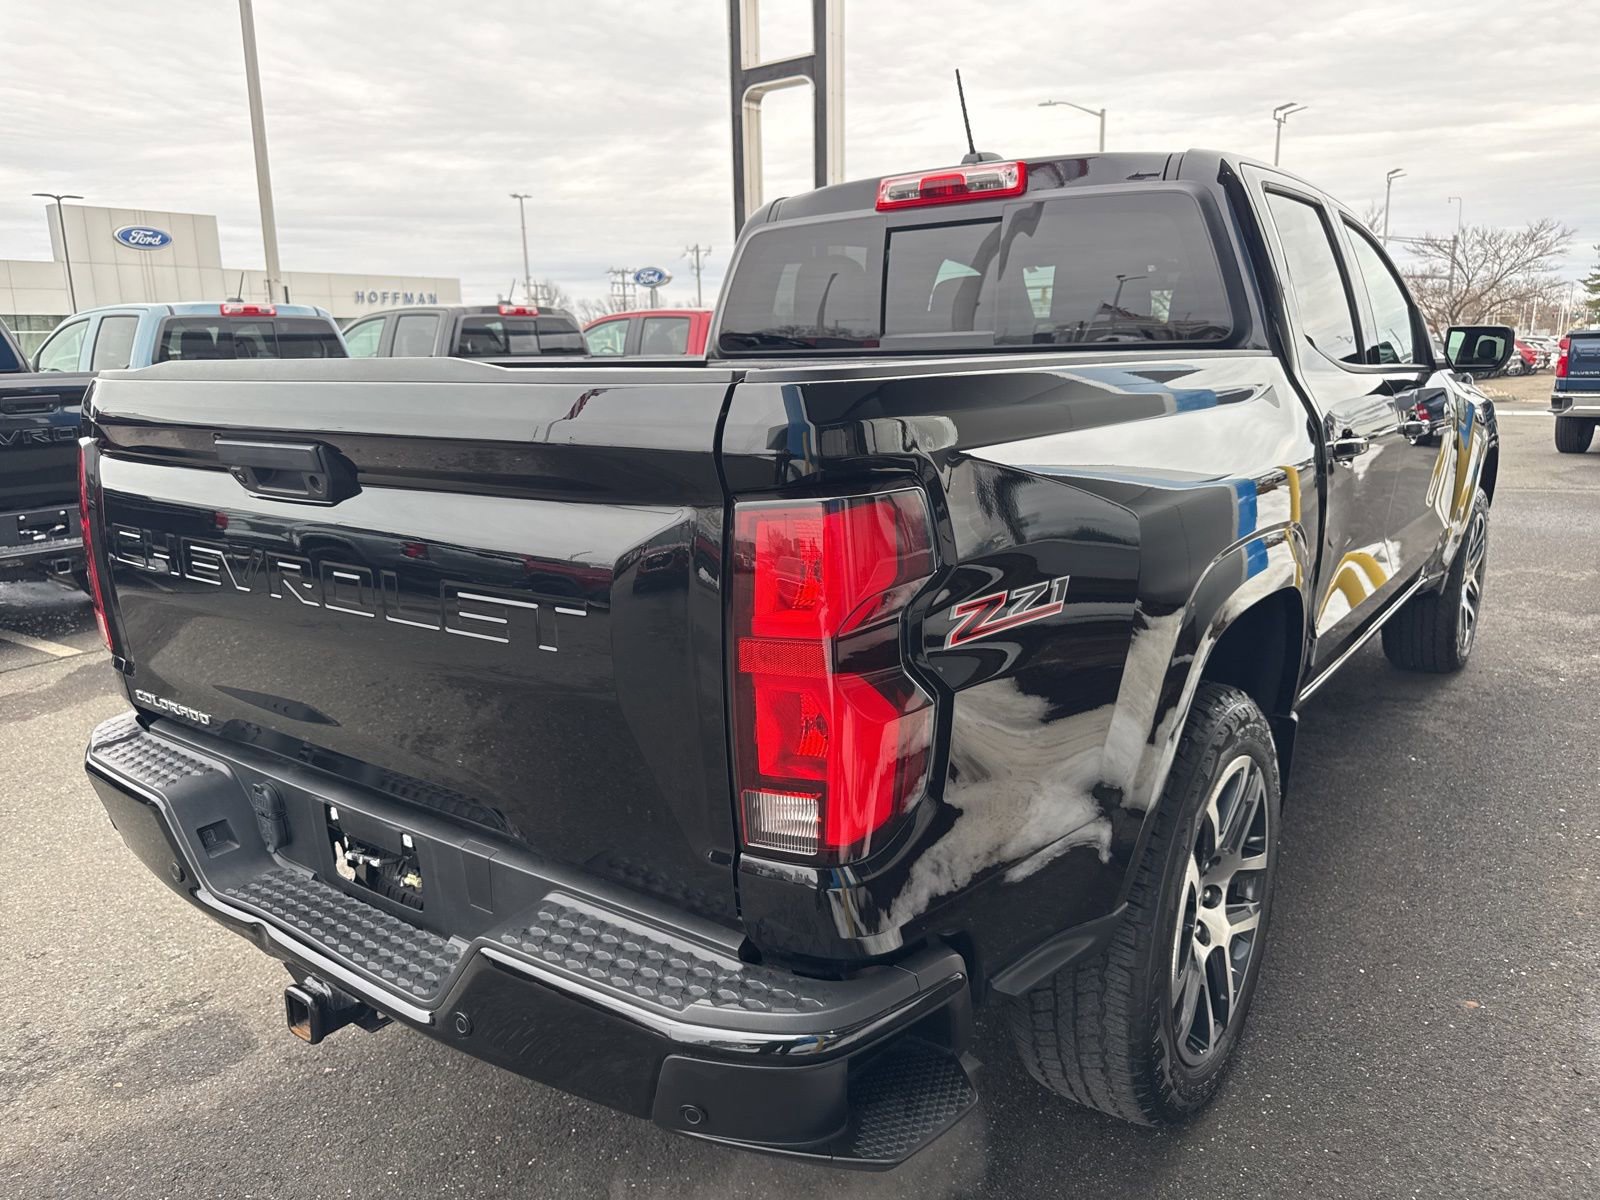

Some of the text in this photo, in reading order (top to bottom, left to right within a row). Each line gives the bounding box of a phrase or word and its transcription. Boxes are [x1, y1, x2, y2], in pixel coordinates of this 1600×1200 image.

[128, 229, 162, 246] Ford
[354, 291, 438, 305] HOFFMAN
[110, 522, 588, 653] CHEVROLET
[943, 574, 1071, 651] Z71
[135, 689, 211, 725] COLORADO
